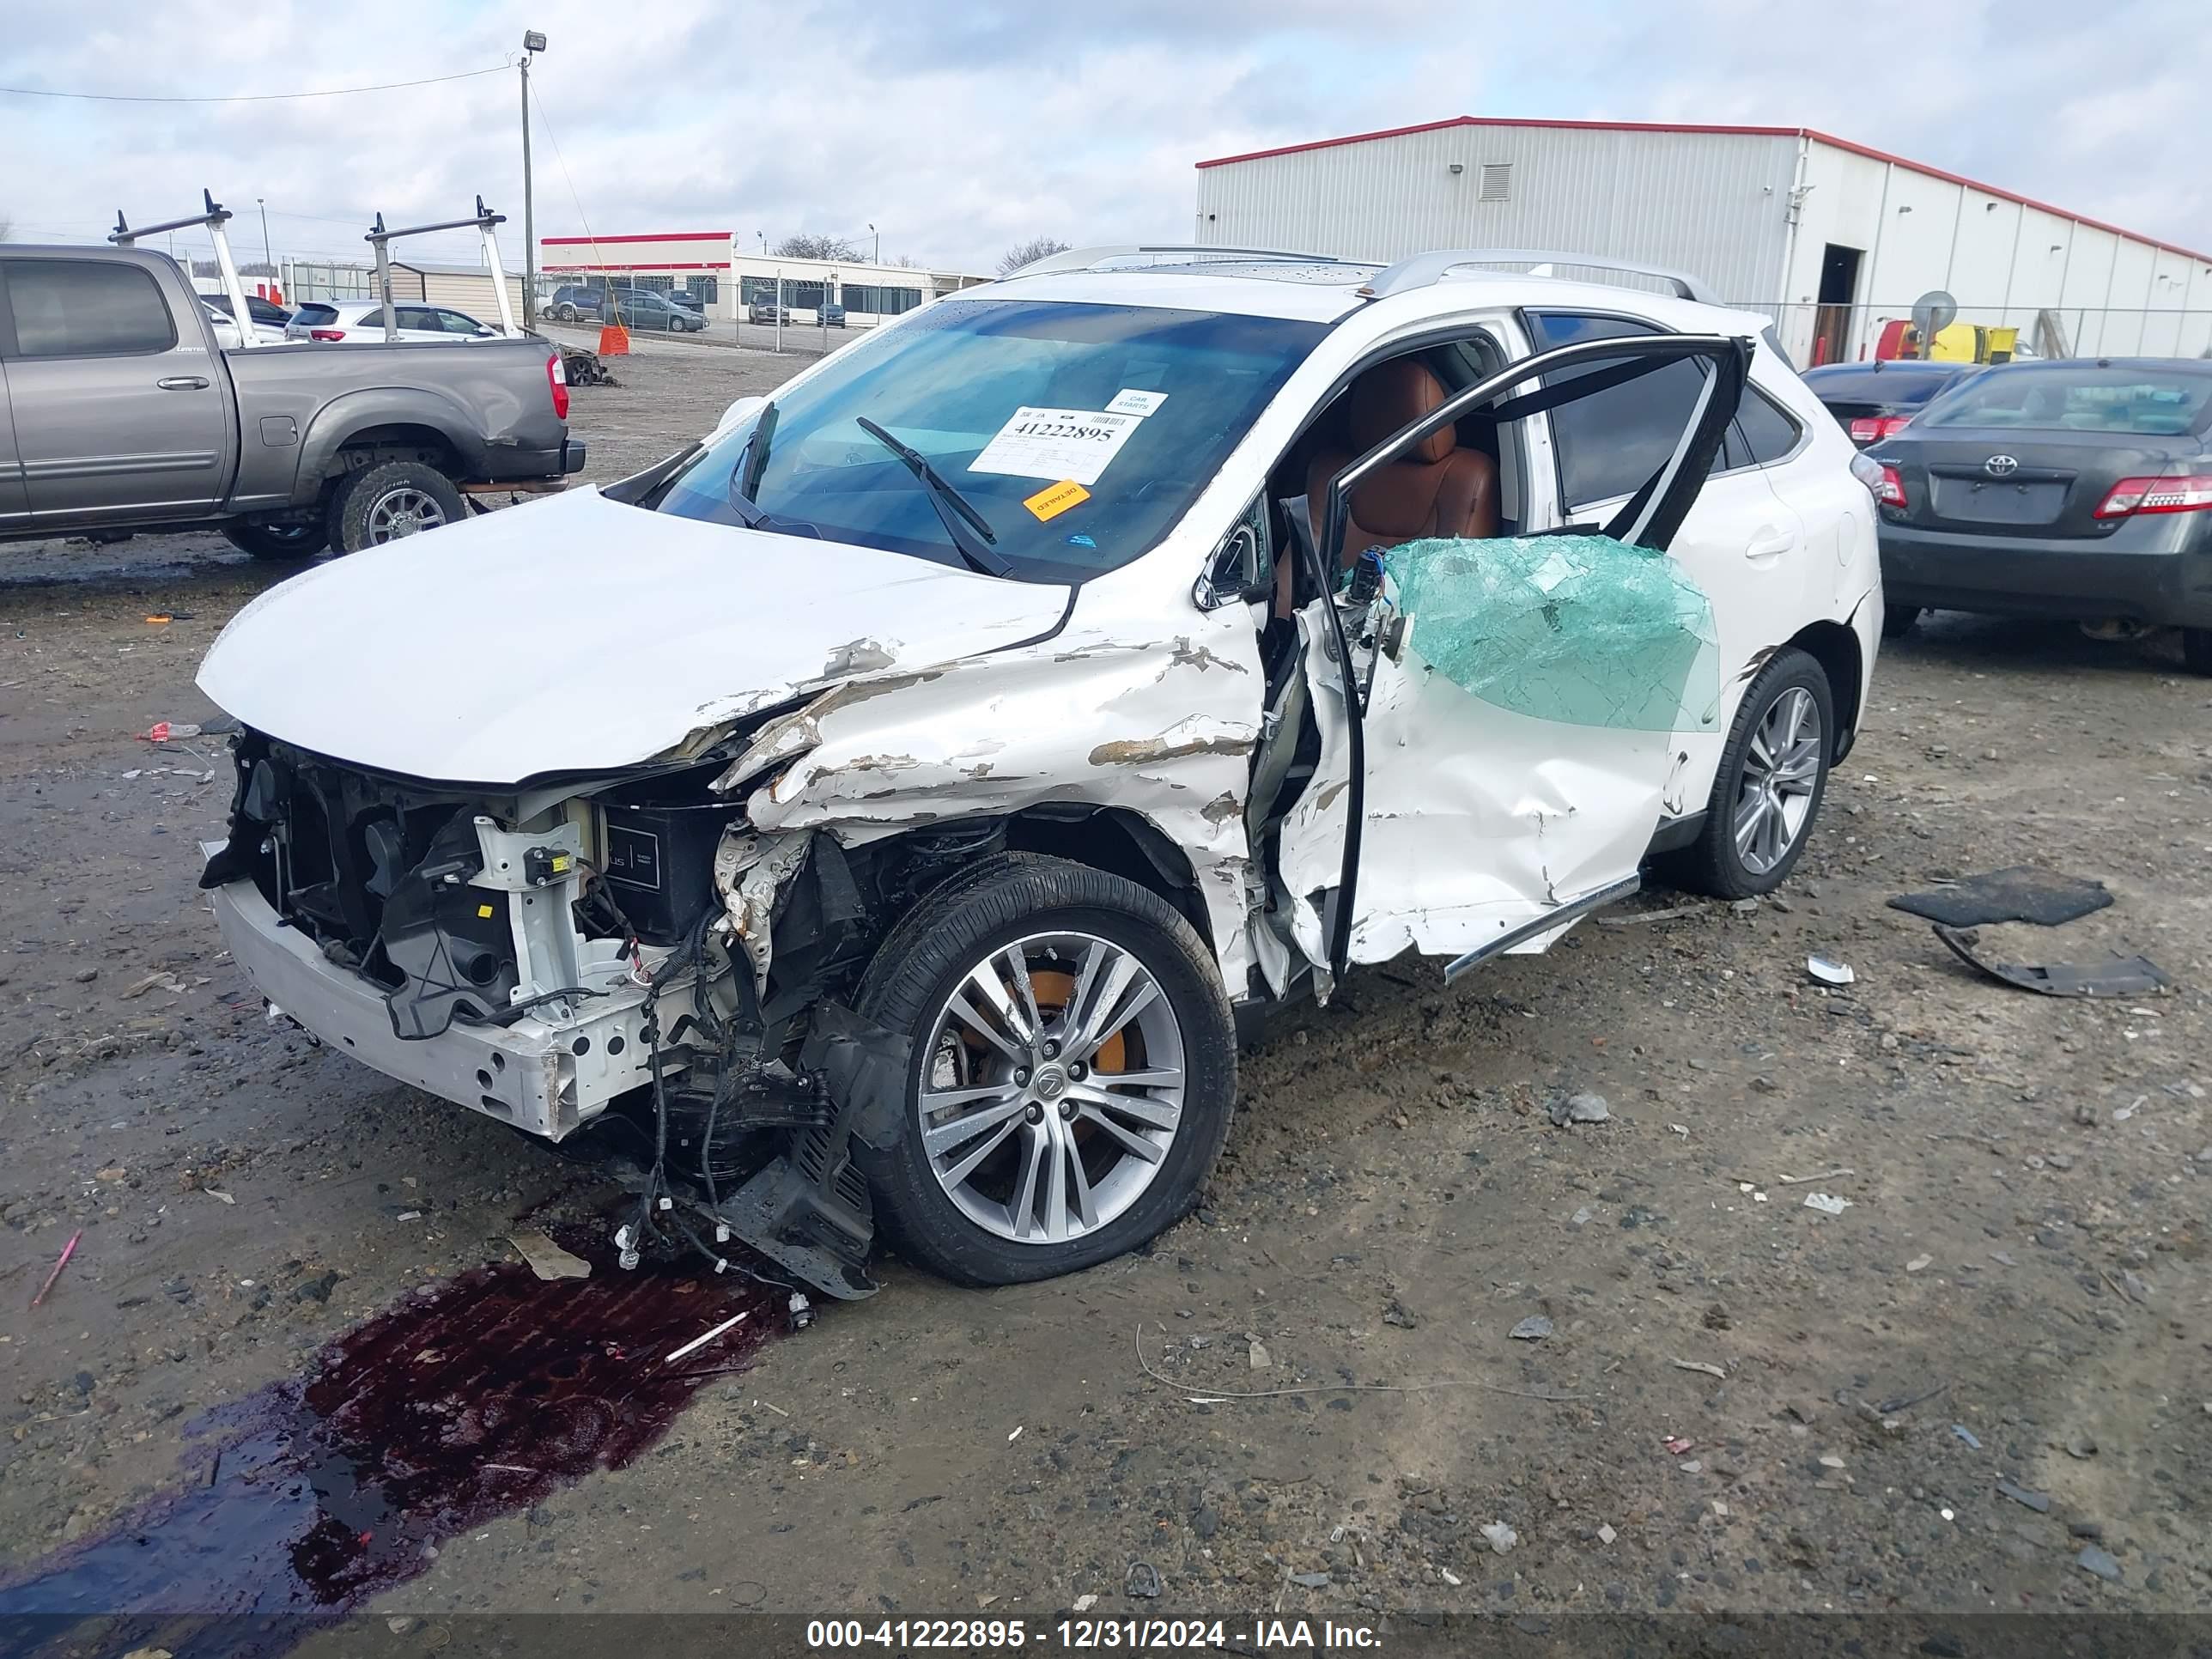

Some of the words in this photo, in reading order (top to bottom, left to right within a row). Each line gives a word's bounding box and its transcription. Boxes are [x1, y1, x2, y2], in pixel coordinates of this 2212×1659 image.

[1117, 401, 1149, 410] STARTS
[1015, 422, 1115, 442] 41222895
[1036, 487, 1078, 511] DETAILED
